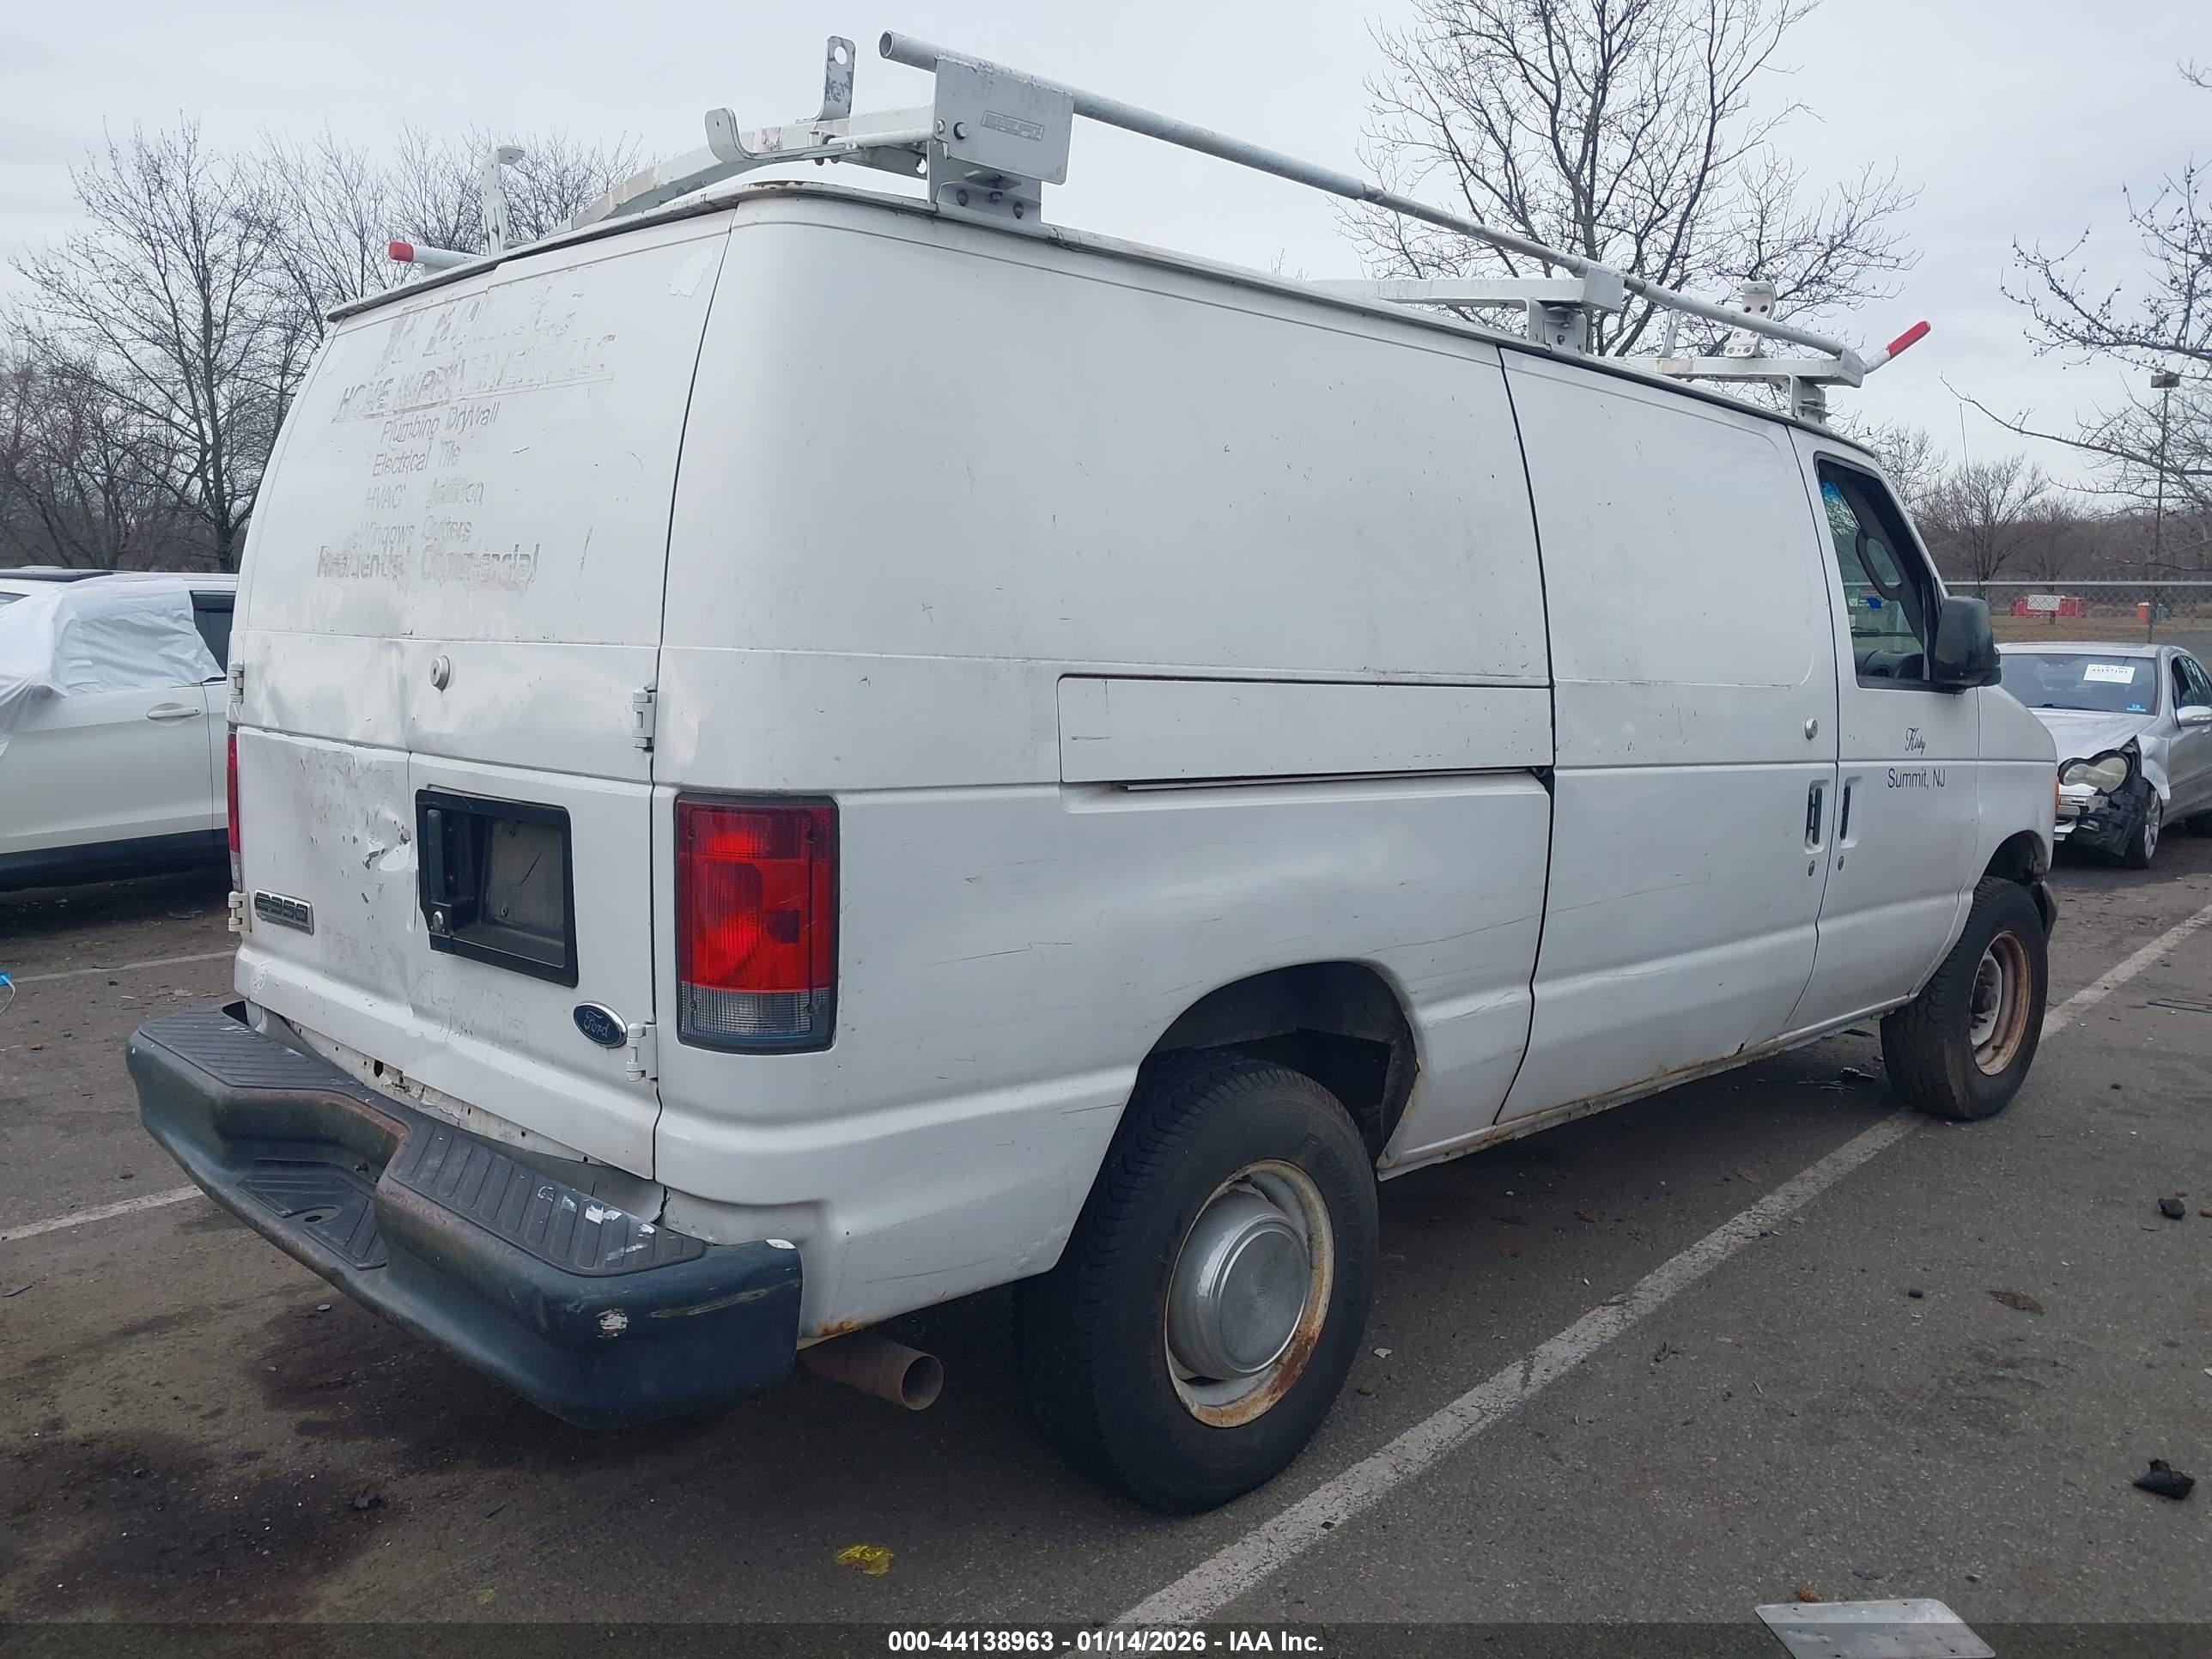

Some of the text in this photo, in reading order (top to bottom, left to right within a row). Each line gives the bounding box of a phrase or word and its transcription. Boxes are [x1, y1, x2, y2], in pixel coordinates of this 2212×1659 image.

[1887, 768, 1946, 790] Summit, NJ
[584, 1010, 611, 1038] Ford
